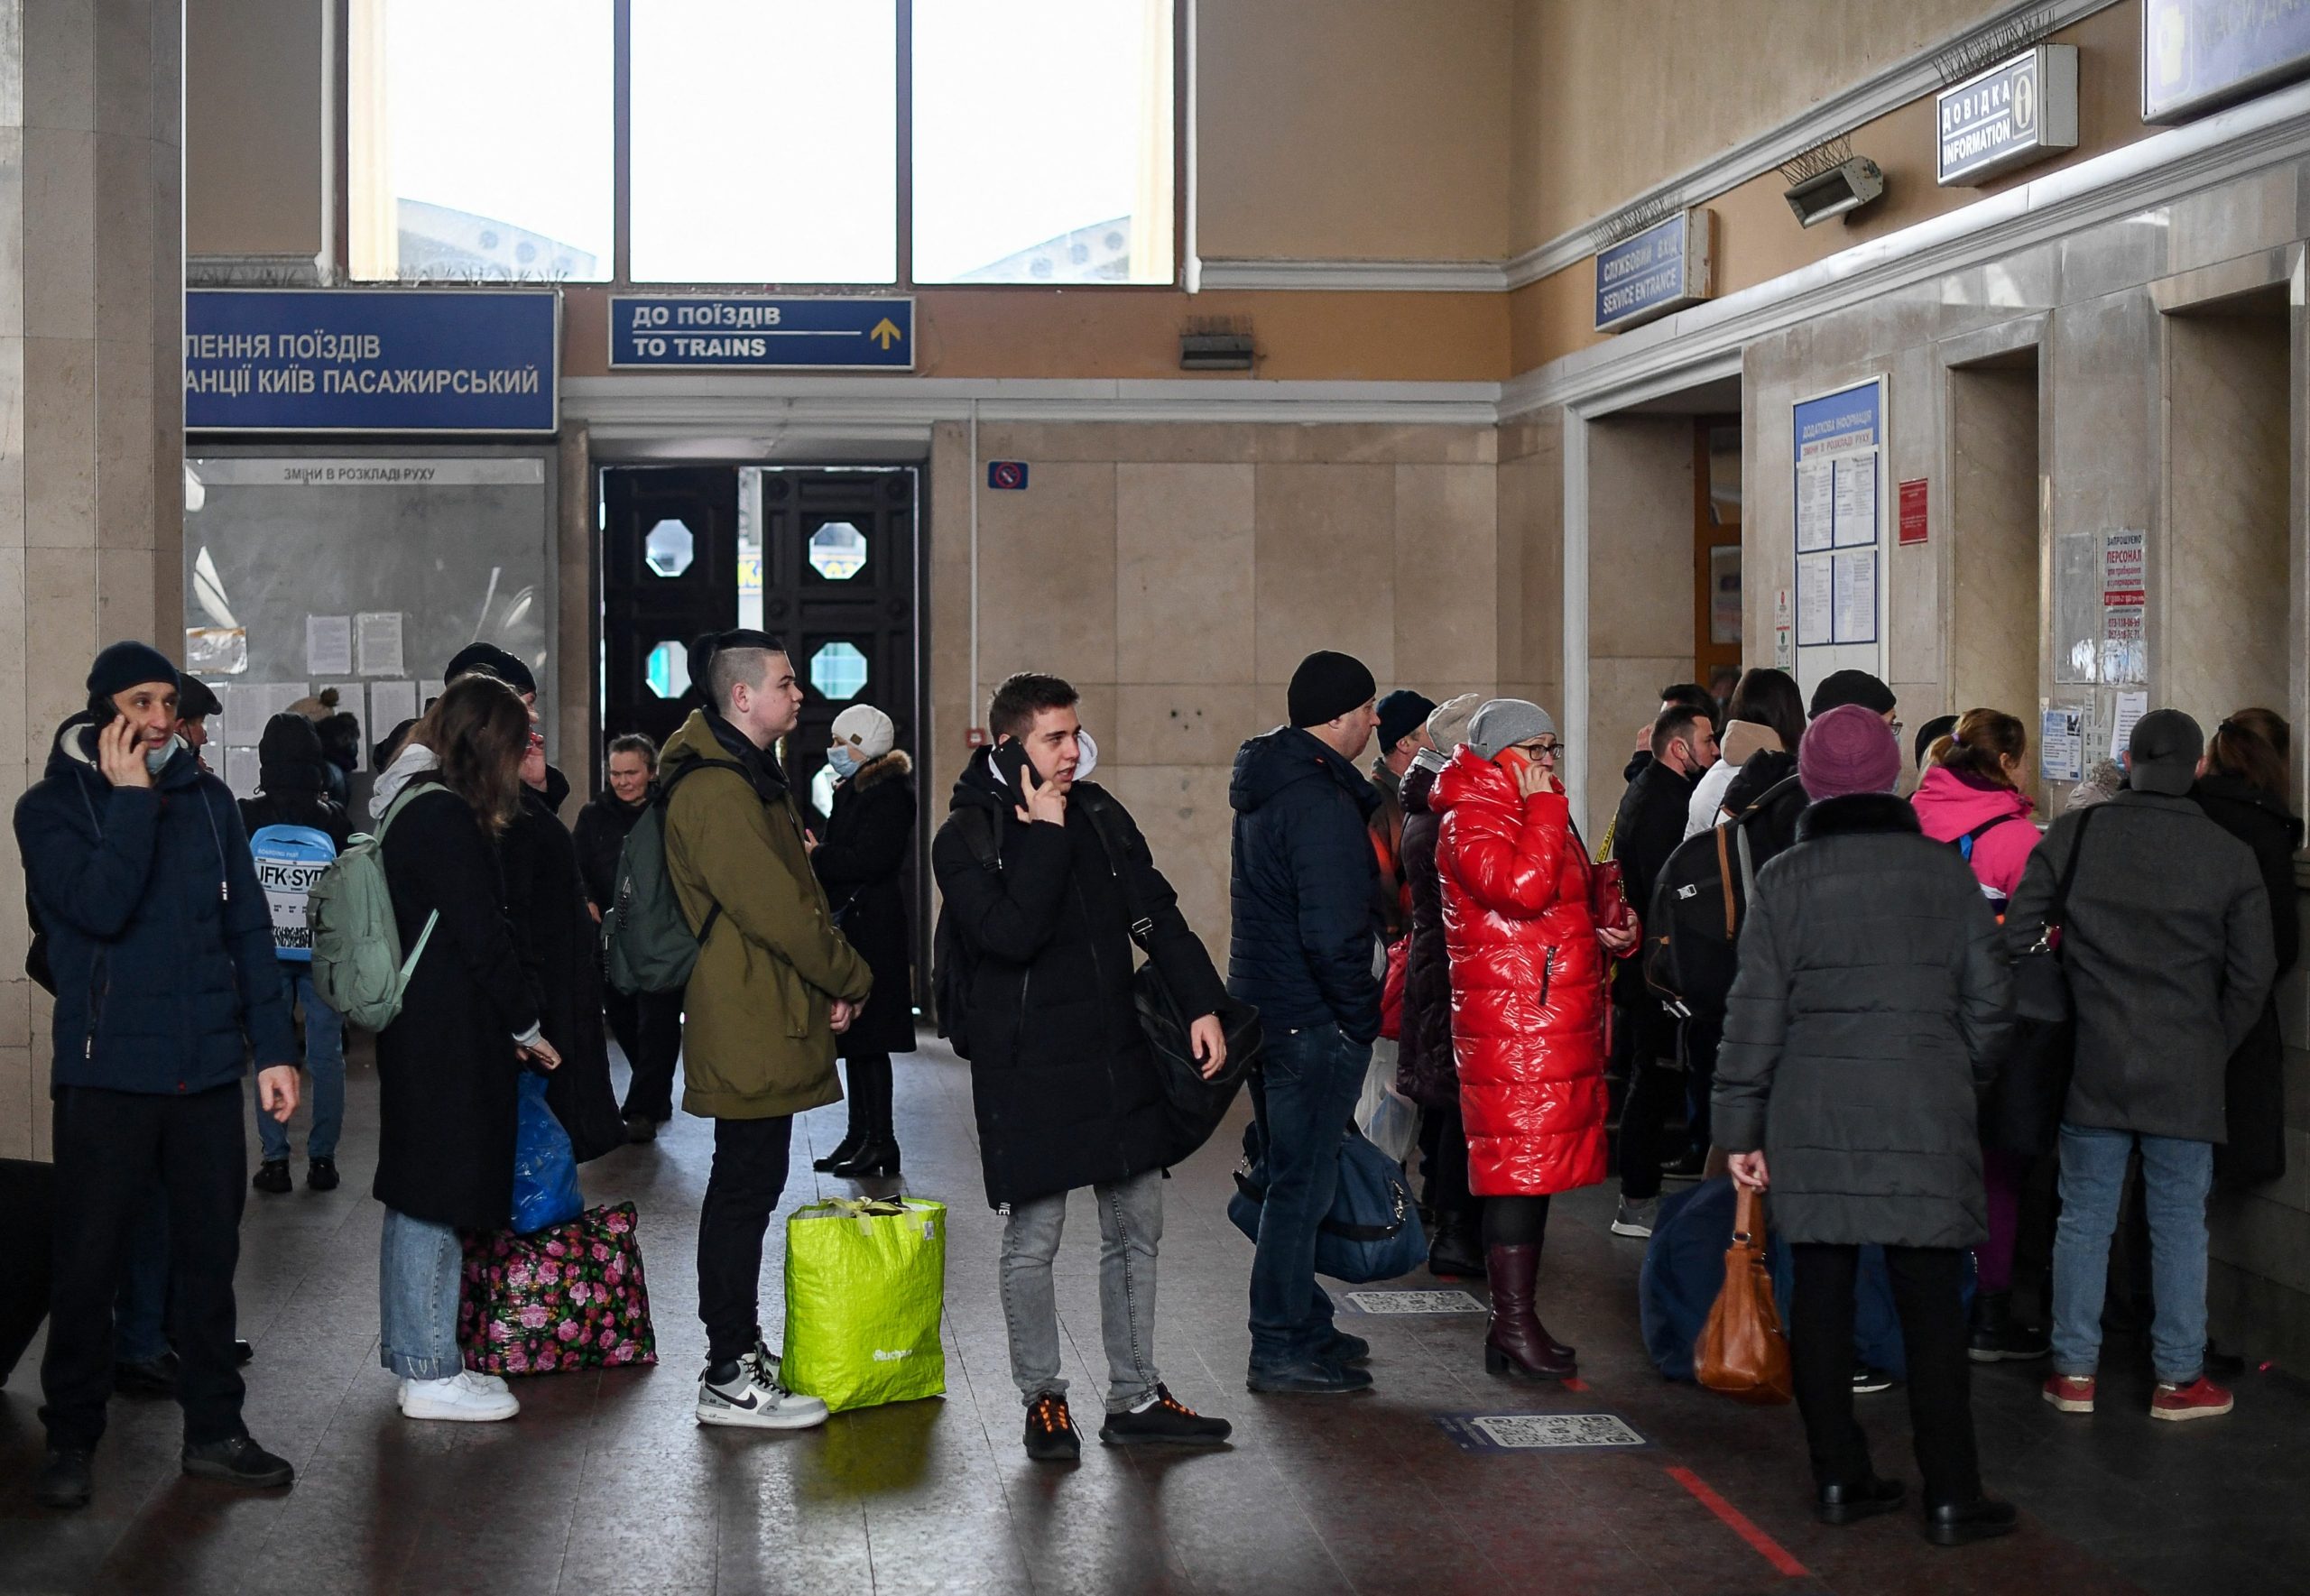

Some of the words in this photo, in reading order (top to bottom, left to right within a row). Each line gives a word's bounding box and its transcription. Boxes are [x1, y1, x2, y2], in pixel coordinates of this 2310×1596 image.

[1943, 79, 2010, 134] ДОВІДКА
[1943, 118, 2010, 166] INFORMATION
[1603, 285, 1634, 314] SERVICE
[1635, 268, 1677, 301] ENTRANCE
[633, 307, 670, 328] ДО
[678, 303, 781, 328] ПОЇЗДІВ
[278, 329, 382, 363] ПОЇЗДІВ
[633, 338, 666, 356] TO
[673, 338, 766, 356] TRAINS
[258, 364, 316, 394] КИЇВ
[323, 363, 540, 394] ПАСАЖИРСЬКИЙ
[284, 468, 323, 481] ЗМІНИ
[327, 468, 335, 480] В
[338, 468, 401, 482] РОЗКЛАДІ
[403, 468, 435, 480] РУХУ
[2107, 549, 2141, 564] ПЕРСОНАЛ
